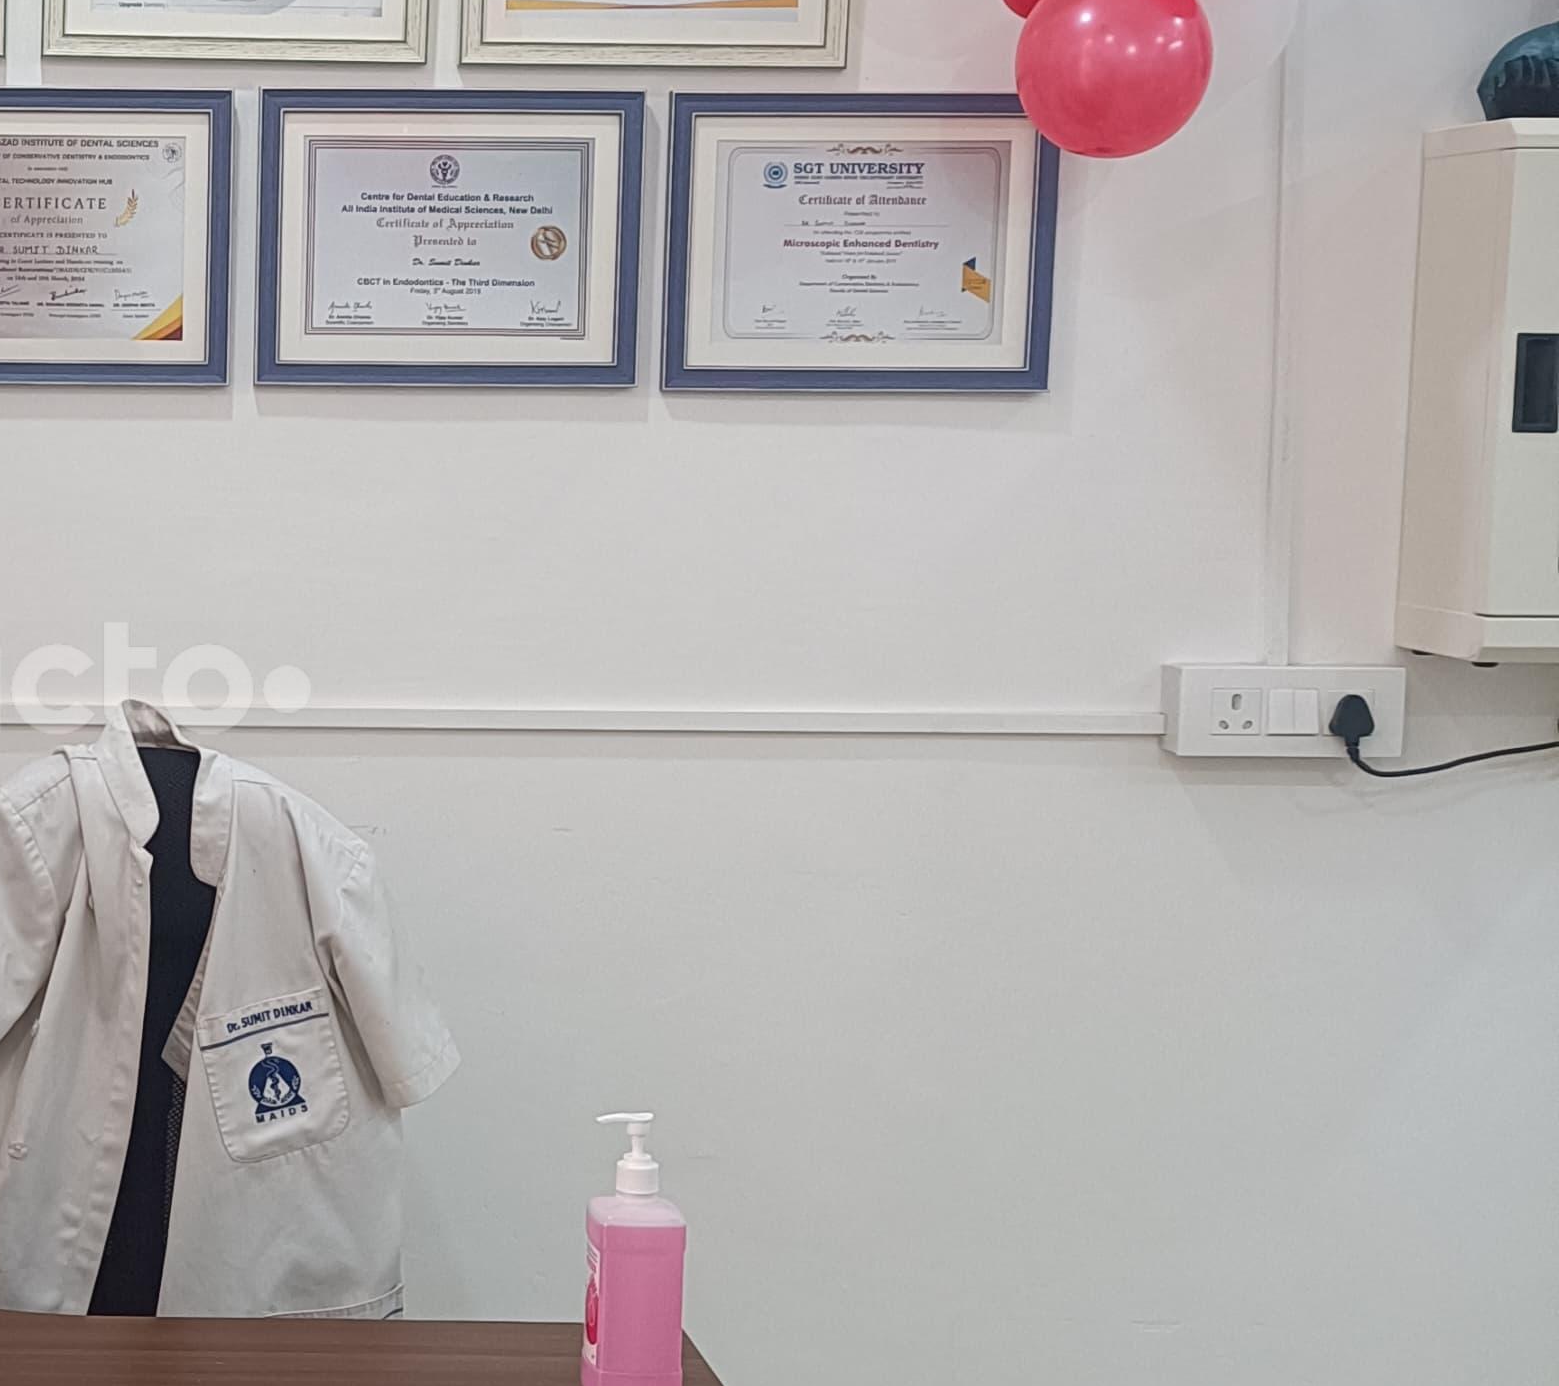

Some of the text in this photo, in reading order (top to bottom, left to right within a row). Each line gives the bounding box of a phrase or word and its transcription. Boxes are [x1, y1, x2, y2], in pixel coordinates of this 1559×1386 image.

[21, 139, 65, 147] INSTITUTE
[67, 139, 78, 147] OF
[116, 140, 159, 148] SCIENCES
[794, 163, 925, 175] SGT UNIVERSITY
[361, 193, 534, 202] Centre for Dental Education & Research
[798, 195, 927, 206] Certificate of Attendance
[342, 205, 553, 215] All India Institute of Medical Sciences, New Delhi
[10, 215, 83, 226] of Appreciation
[376, 218, 514, 231] Certificate of Appreciation
[413, 235, 476, 247] Presented to
[784, 240, 939, 250] Microscopic Enhanced Dentistry
[13, 246, 48, 254] SUMIT
[56, 245, 98, 254] DINKAR
[357, 278, 381, 286] CBCT
[383, 278, 390, 286] in
[393, 278, 444, 286] Endodontics
[452, 279, 466, 287] The
[468, 279, 489, 287] Third
[492, 279, 535, 287] Dimension
[227, 1002, 313, 1033] Dr. SUMIT DINKAR
[256, 1105, 308, 1123] MAIDS
